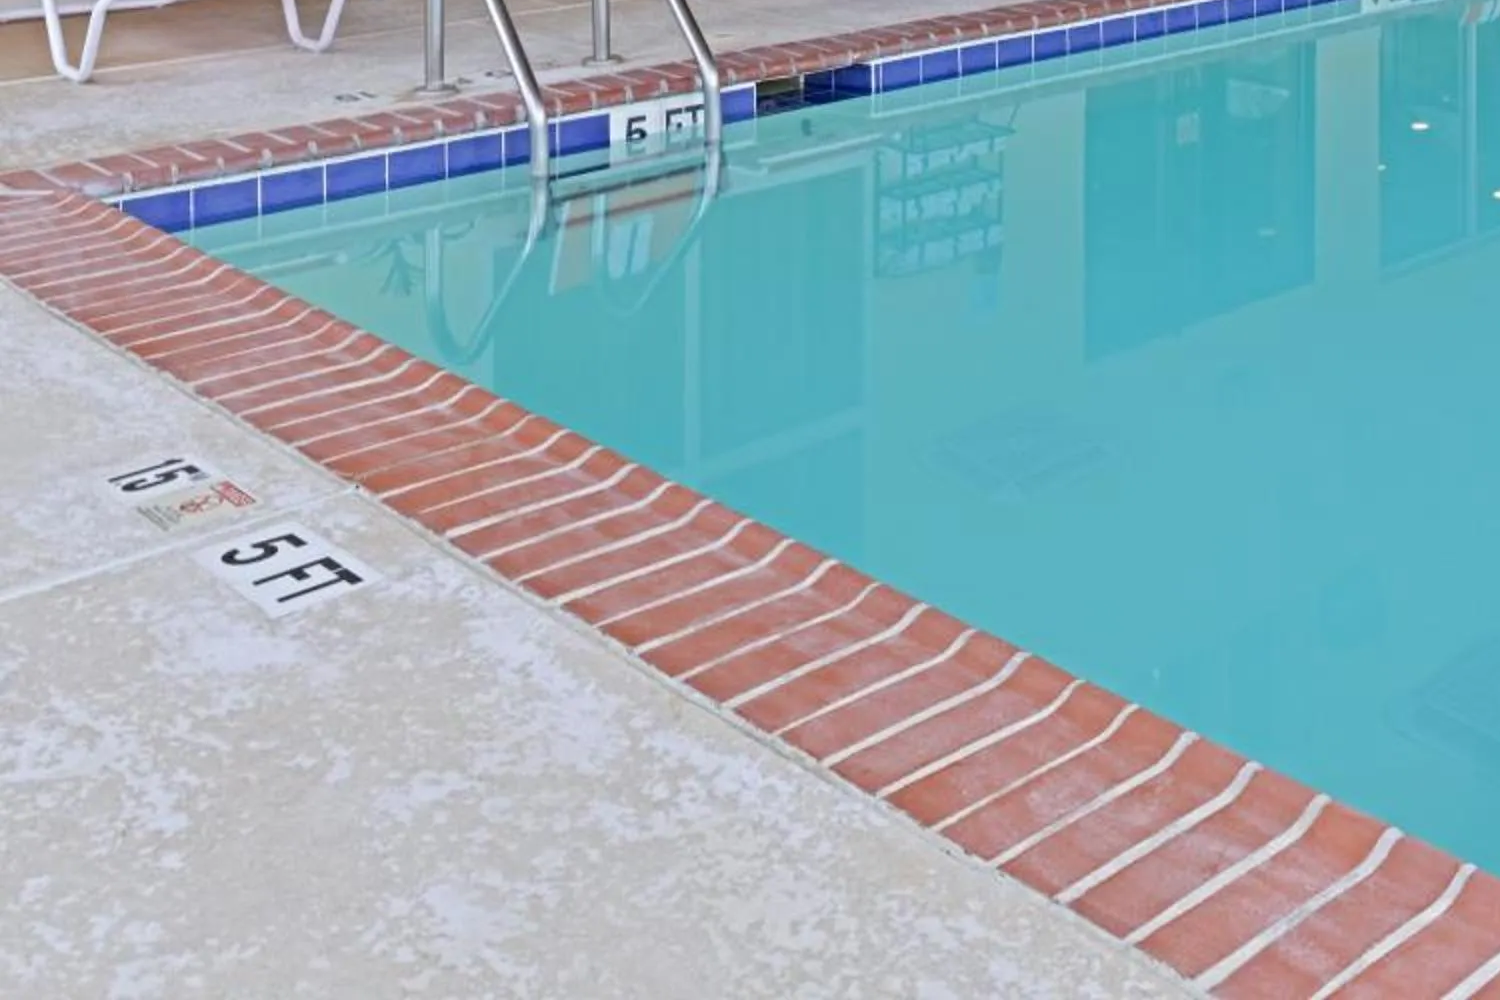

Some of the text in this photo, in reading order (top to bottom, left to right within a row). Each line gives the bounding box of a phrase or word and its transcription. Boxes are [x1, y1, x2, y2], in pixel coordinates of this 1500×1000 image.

[626, 103, 704, 141] 5 FT
[221, 533, 364, 603] 5 FT
